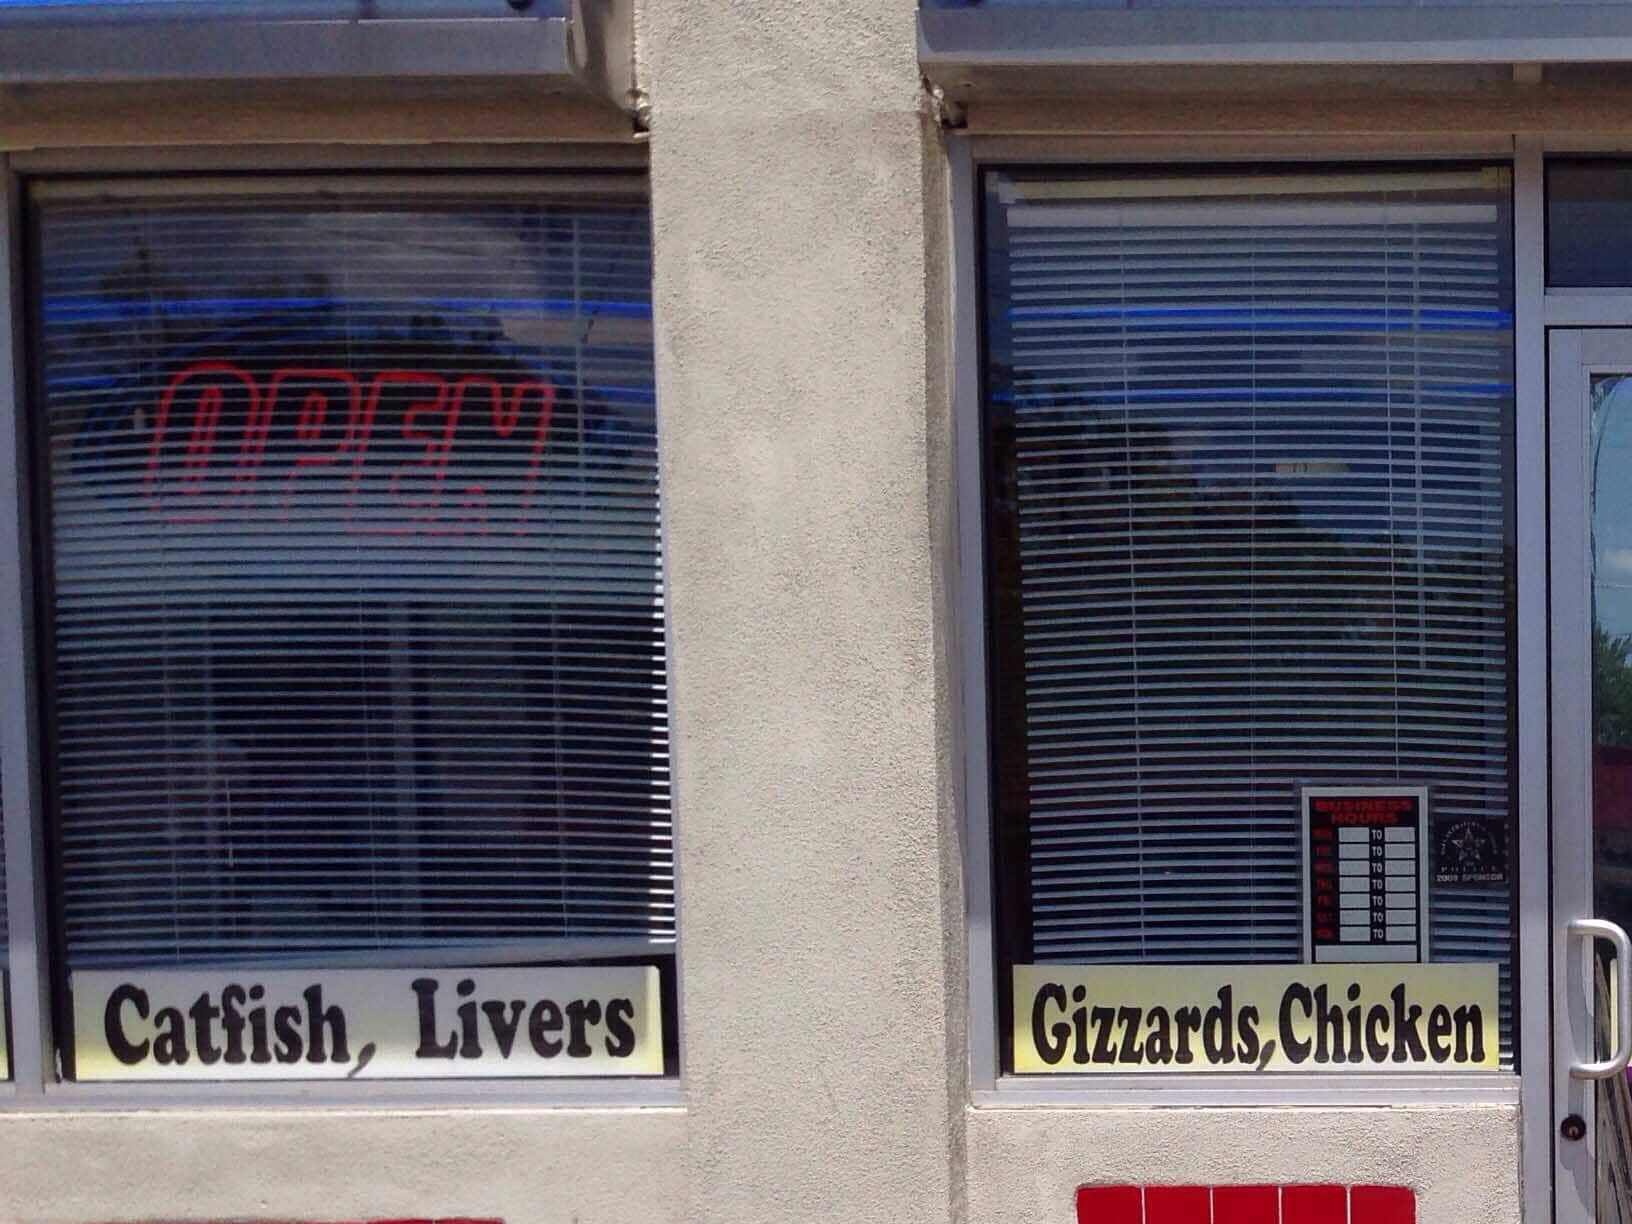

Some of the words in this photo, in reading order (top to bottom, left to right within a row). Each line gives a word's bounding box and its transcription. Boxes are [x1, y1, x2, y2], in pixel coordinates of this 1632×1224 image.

[143, 359, 557, 536] OPEN
[1371, 829, 1383, 840] TO
[1371, 846, 1383, 856] TO
[1371, 863, 1383, 873] TO
[1371, 879, 1383, 890] TO
[1372, 895, 1384, 906] TO
[1372, 911, 1384, 923] TO
[1372, 928, 1384, 939] TO
[104, 978, 377, 1080] Catfish,
[411, 977, 636, 1060] Livers
